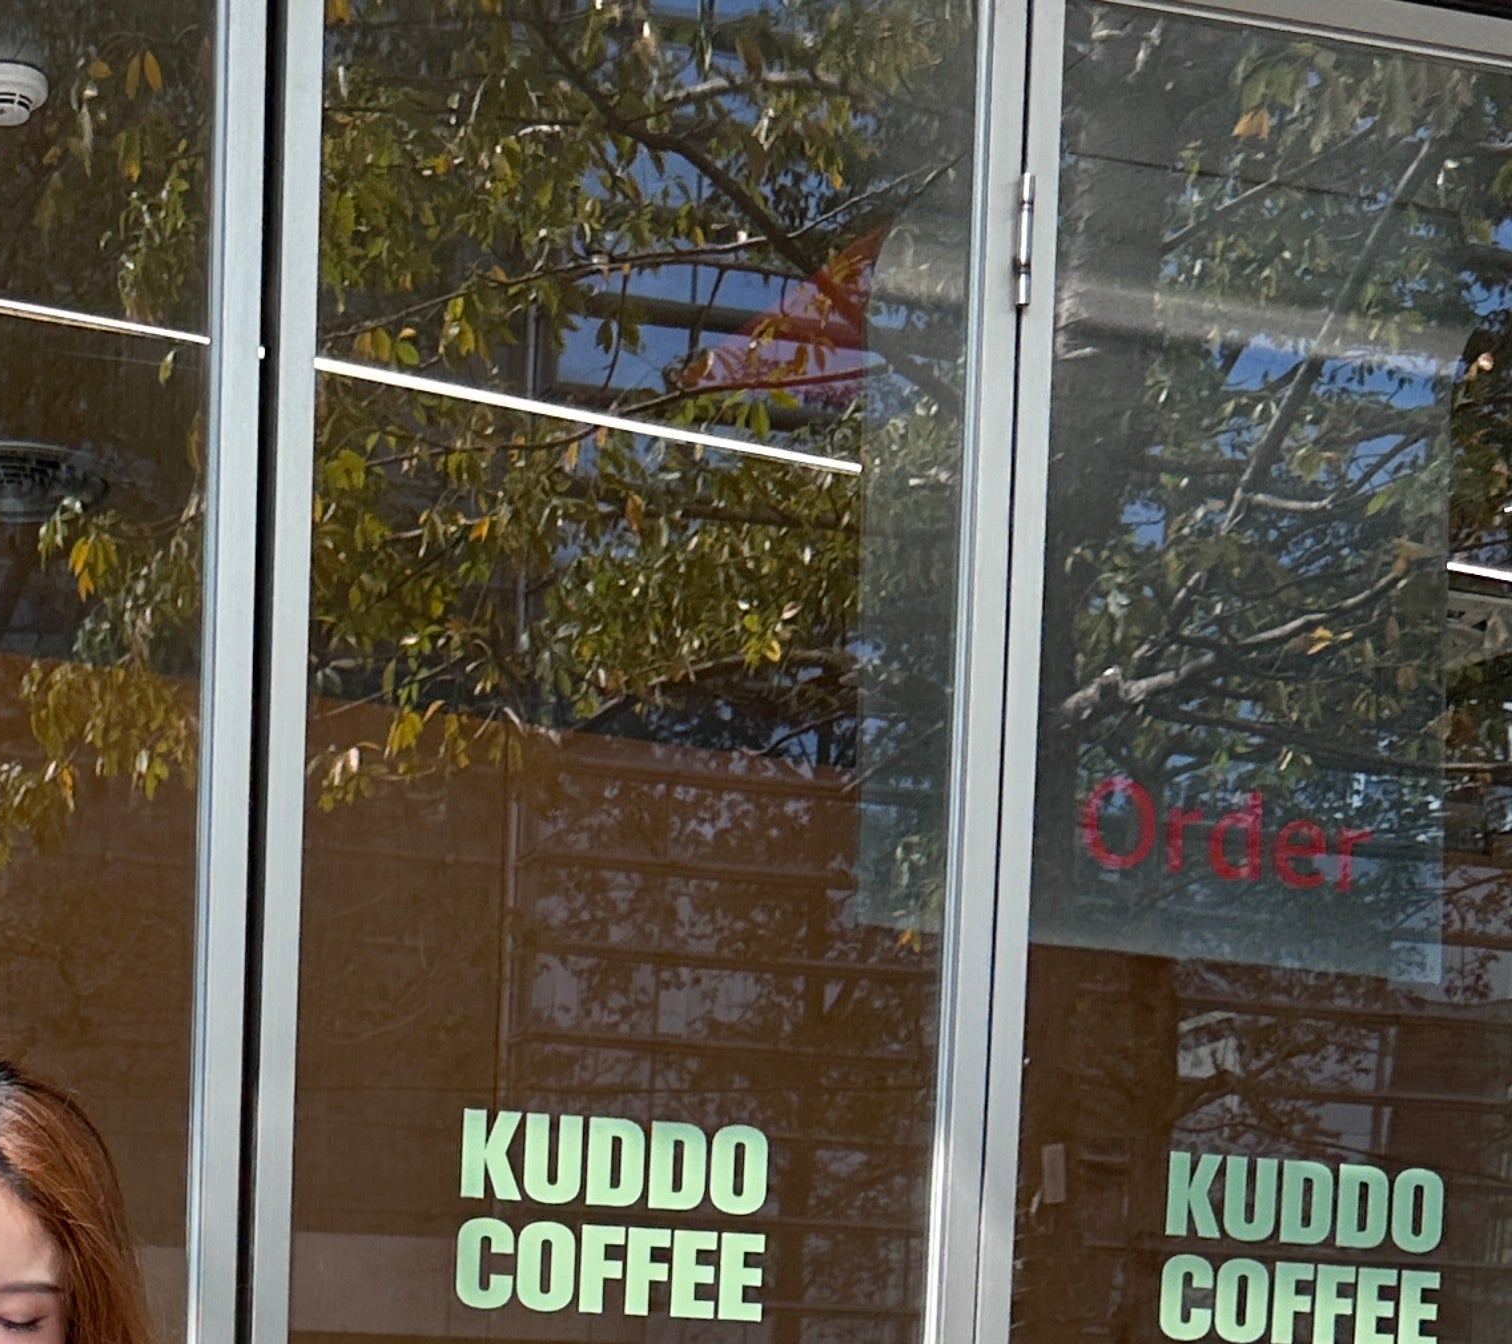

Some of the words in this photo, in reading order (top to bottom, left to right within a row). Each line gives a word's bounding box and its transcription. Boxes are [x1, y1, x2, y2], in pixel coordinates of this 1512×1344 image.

[1081, 774, 1374, 891] Order
[460, 1107, 769, 1216] KUDDO
[1165, 1150, 1445, 1254] KUDDO
[455, 1216, 766, 1322] COFFEE
